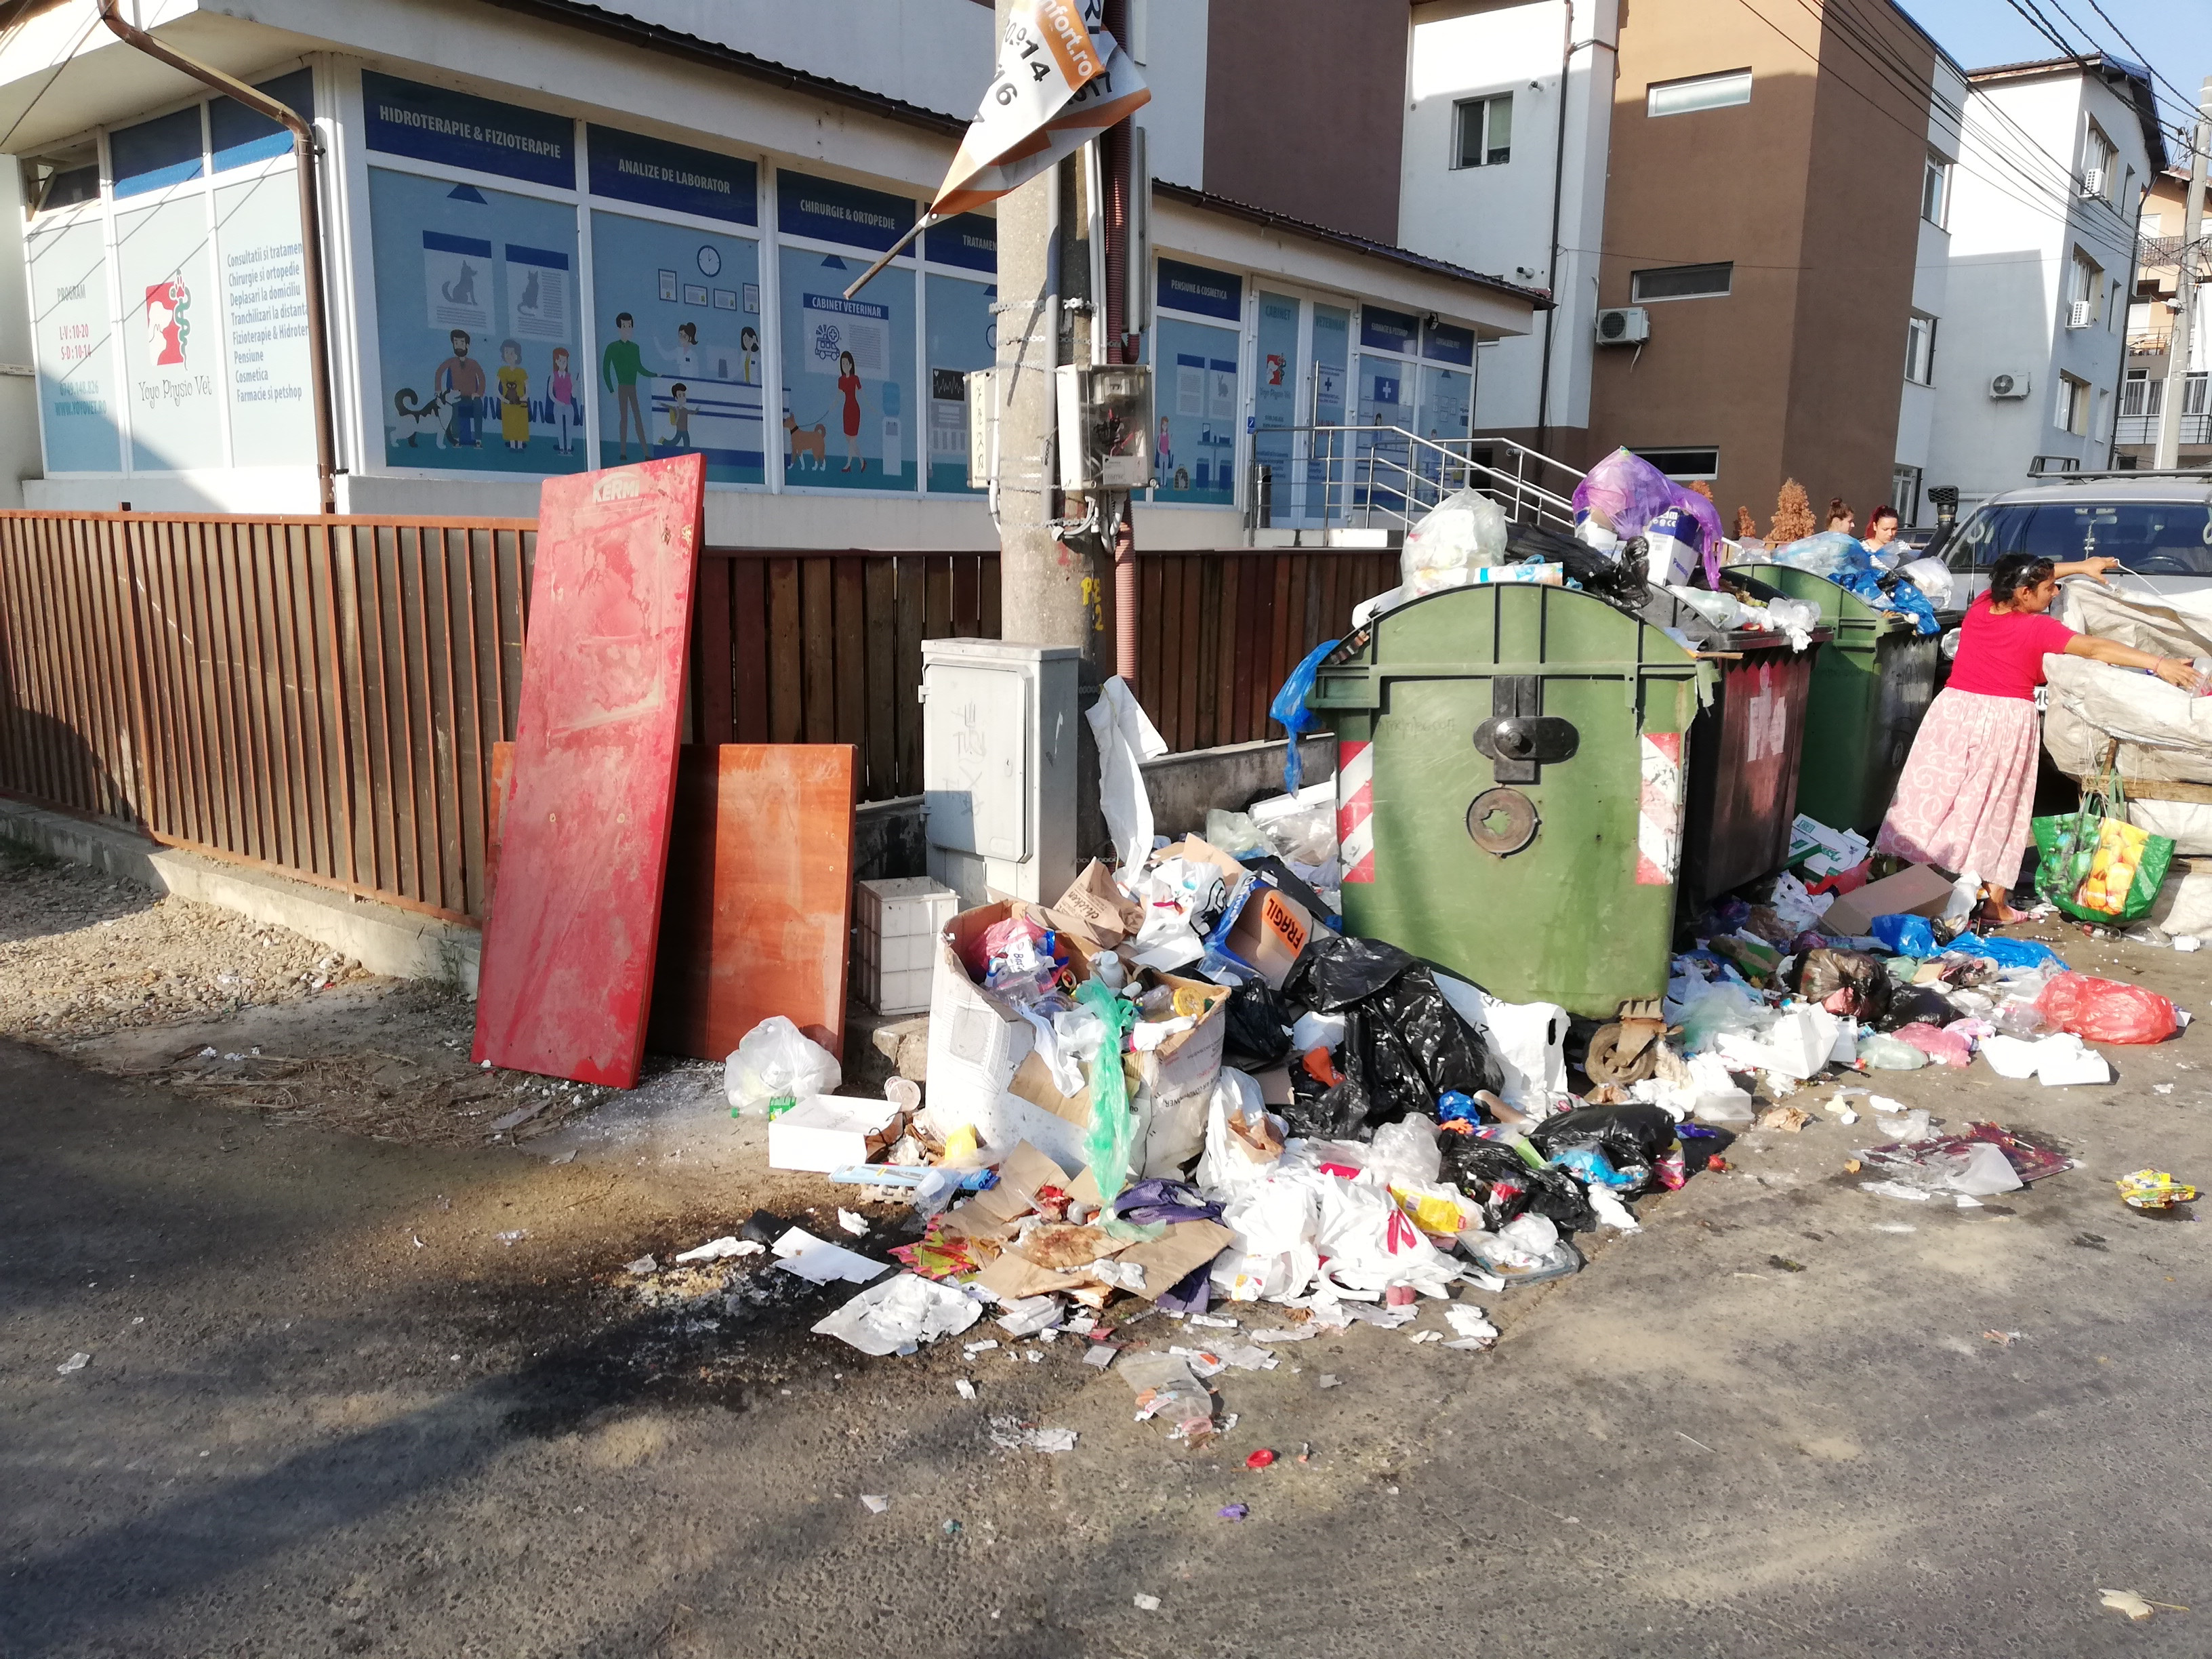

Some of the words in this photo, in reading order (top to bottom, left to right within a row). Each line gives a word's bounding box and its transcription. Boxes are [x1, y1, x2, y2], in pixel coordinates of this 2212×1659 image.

[380, 104, 471, 139] HIDROTERAPIE
[474, 126, 483, 141] &
[485, 128, 561, 159] FIZIOTERAPIE
[618, 158, 659, 180] ANALIZE
[661, 167, 674, 182] DE
[676, 170, 731, 194] LABORATOR
[800, 199, 844, 220] CHIRURGIE
[845, 208, 852, 220] &
[853, 211, 895, 230] ORTOPEDIE
[227, 247, 262, 268] Consultatii
[263, 245, 269, 261] si
[228, 268, 258, 287] Chirurgie
[260, 266, 265, 282] si
[266, 261, 300, 281] ortopedie
[57, 284, 86, 302] PROGRAM
[230, 287, 260, 309] Deplasari
[262, 287, 268, 302] la
[269, 281, 301, 300] domiciliu
[1171, 279, 1196, 293] PENSIUNE
[1201, 286, 1227, 300] COSMETICA
[231, 306, 272, 325] Tranchilizari
[272, 305, 279, 319] la
[813, 297, 842, 311] CABINET
[843, 301, 881, 318] VETERINAR
[232, 327, 272, 345] Fizioterapie
[272, 325, 278, 340] &
[234, 348, 264, 365] Pensiune
[235, 367, 268, 384] Cosmetica
[138, 382, 160, 409] Yoyo
[163, 379, 192, 407] Physio
[194, 375, 212, 395] Vet
[237, 386, 266, 403] Farmacie
[268, 385, 273, 400] si
[274, 384, 302, 403] petshop
[592, 476, 640, 504] KERMI
[1067, 890, 1099, 919] chicken
[1266, 898, 1304, 949] FRAGIL
